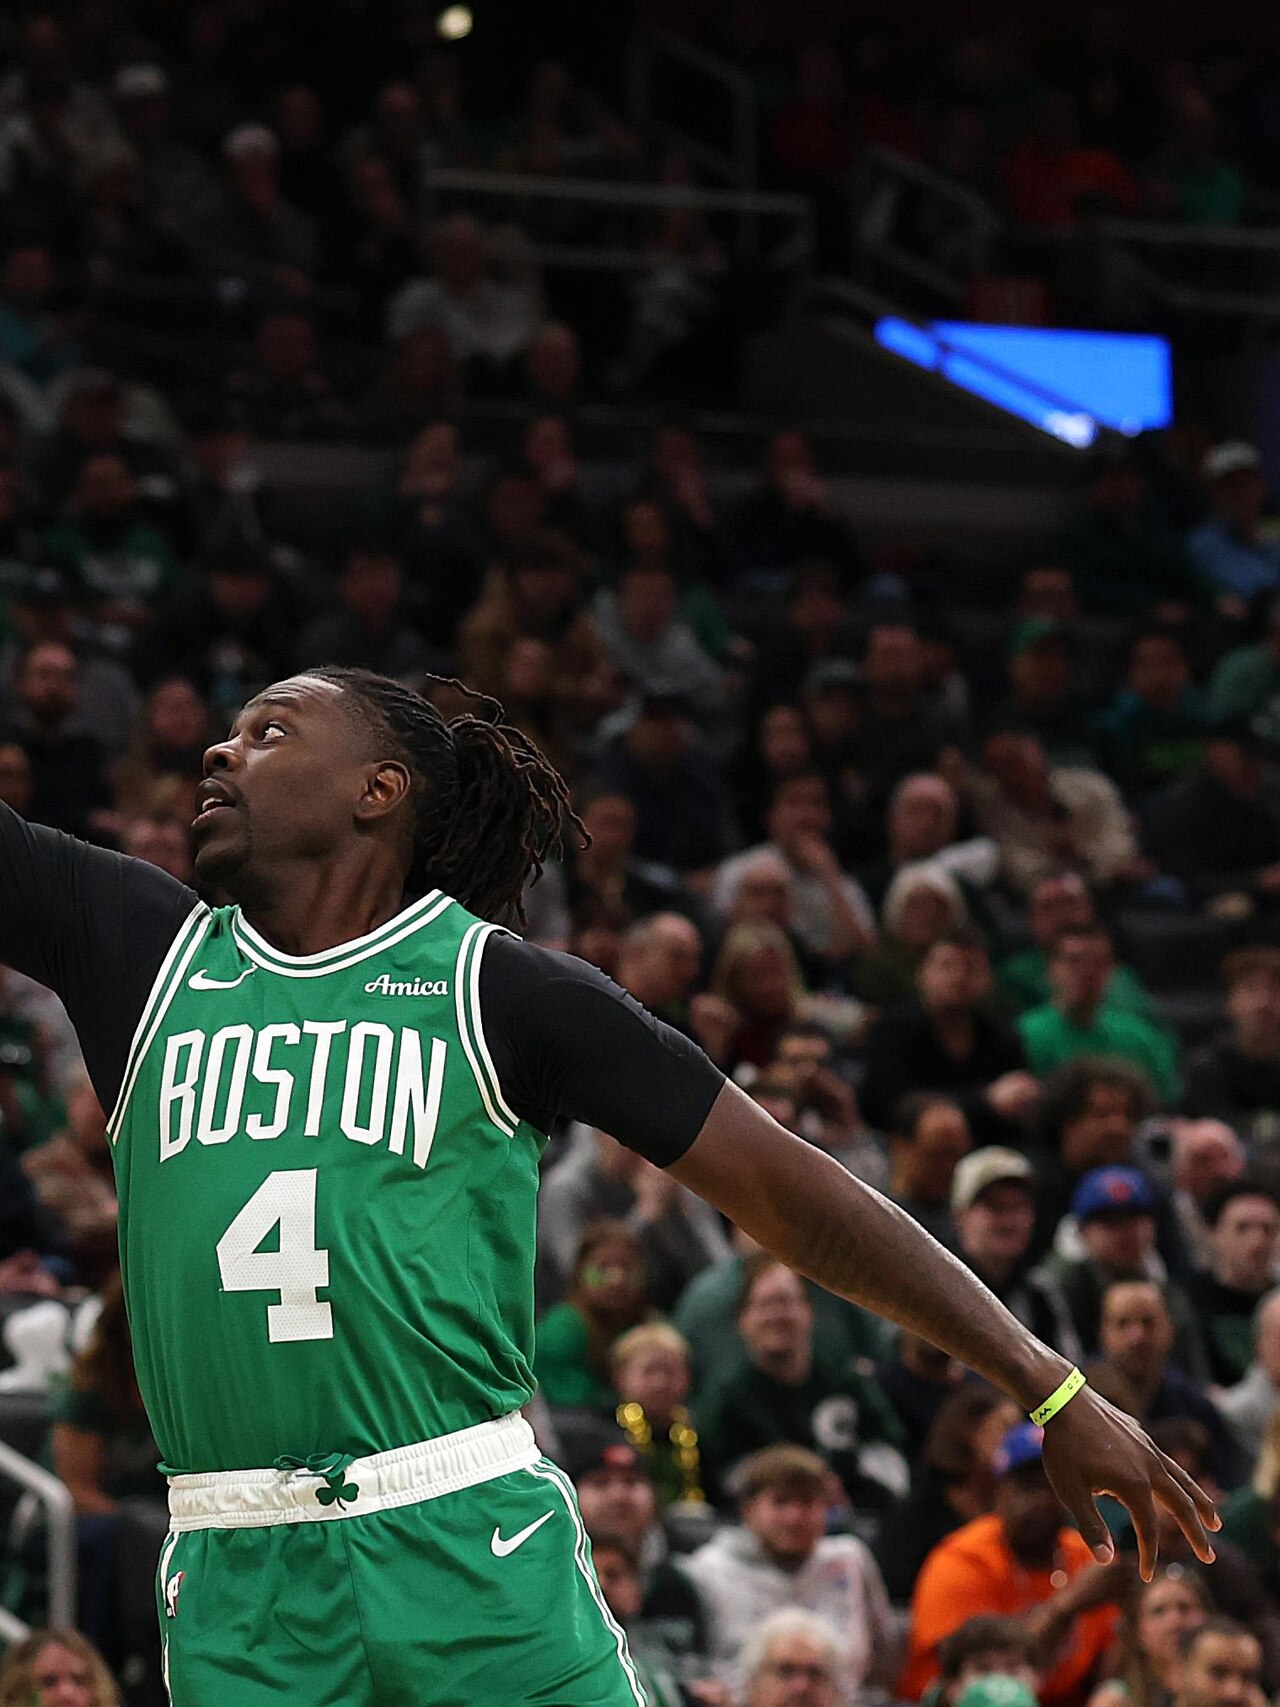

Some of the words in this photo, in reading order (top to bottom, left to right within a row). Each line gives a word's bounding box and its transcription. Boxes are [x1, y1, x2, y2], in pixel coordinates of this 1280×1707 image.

[364, 974, 448, 996] Amica
[159, 1019, 447, 1170] BOSTON
[216, 1168, 333, 1343] 4
